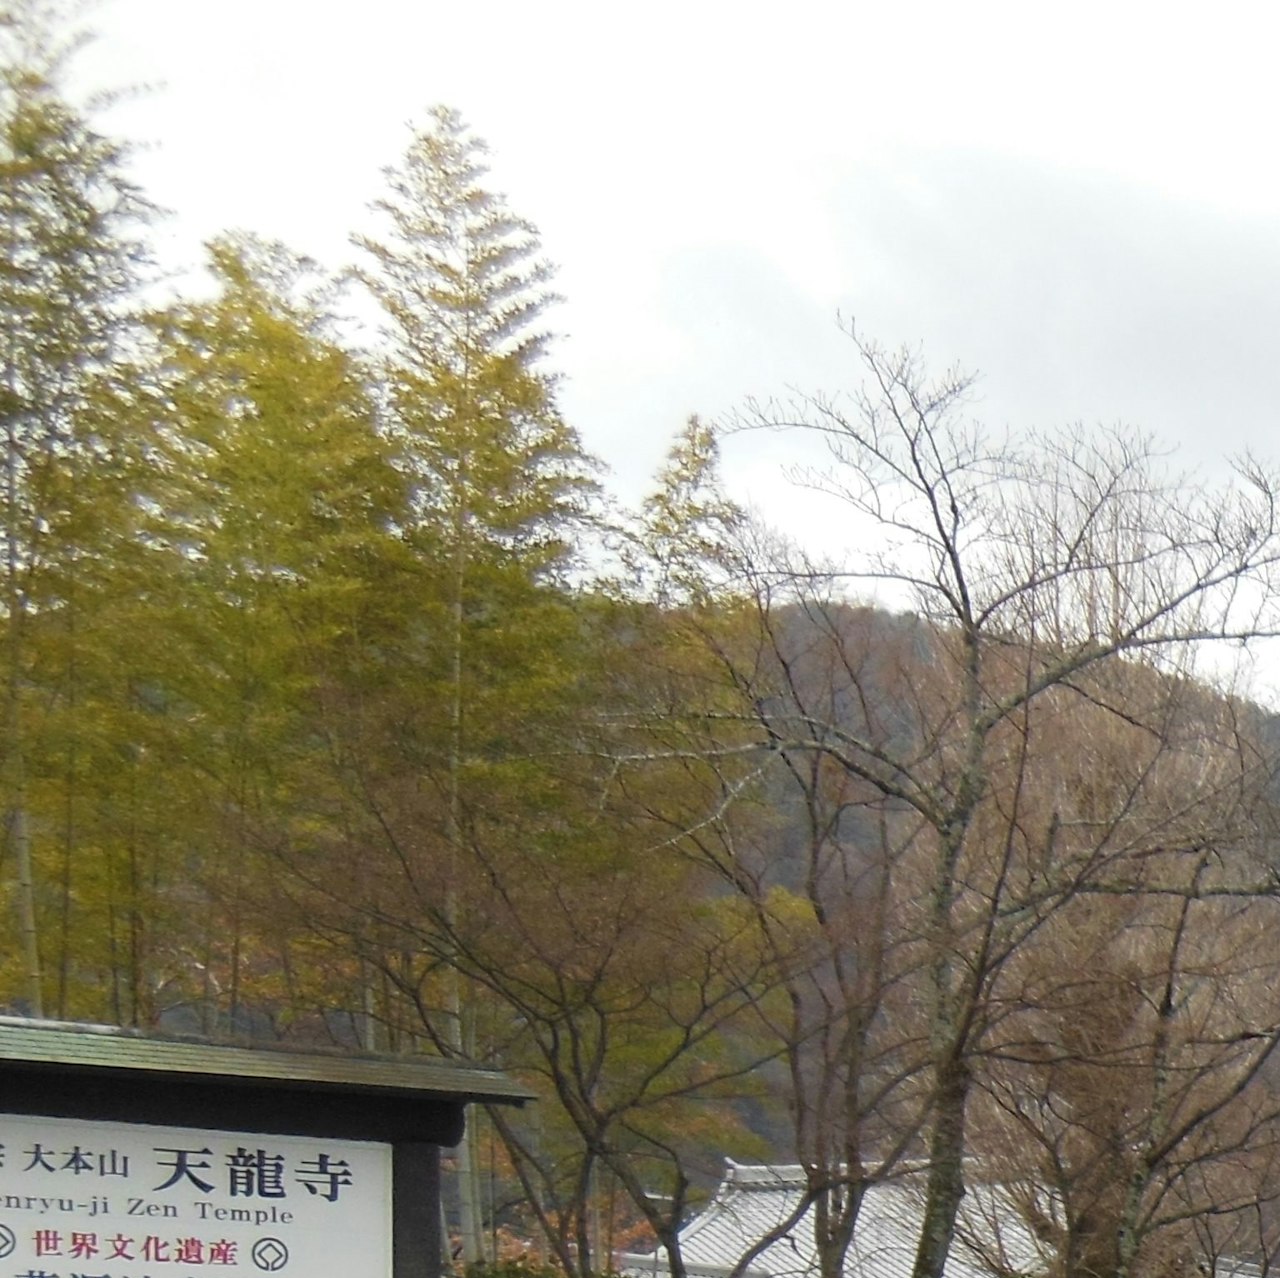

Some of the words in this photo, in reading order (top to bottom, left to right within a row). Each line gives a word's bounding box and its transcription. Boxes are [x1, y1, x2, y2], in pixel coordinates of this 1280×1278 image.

[22, 1143, 130, 1179] 大本山
[151, 1146, 353, 1203] 天龍寺
[0, 1195, 110, 1217] nryu-ji
[127, 1198, 179, 1218] Zen
[194, 1201, 294, 1226] Temple
[31, 1229, 238, 1266] 世界文化遺産
